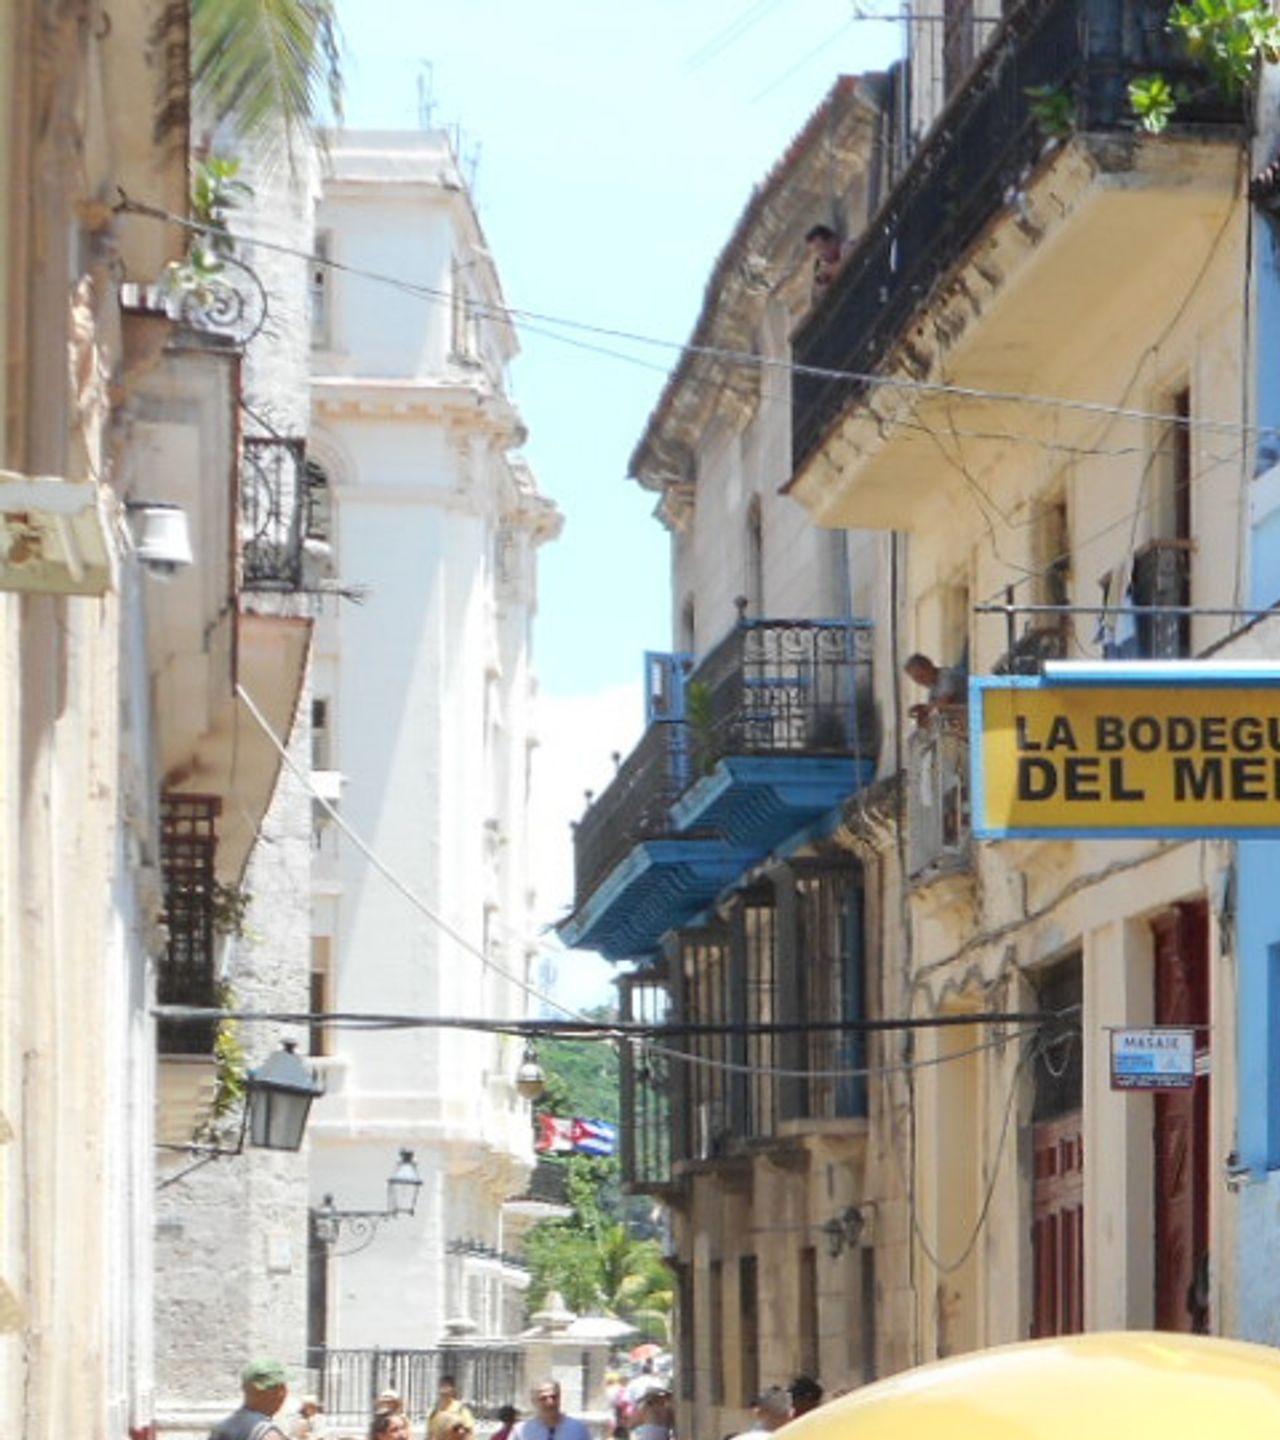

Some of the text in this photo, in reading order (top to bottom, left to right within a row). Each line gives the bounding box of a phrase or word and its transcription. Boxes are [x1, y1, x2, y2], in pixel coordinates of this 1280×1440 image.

[1015, 716, 1077, 752] LA
[1018, 757, 1145, 802] DEL
[1124, 1037, 1179, 1049] MASAJE
